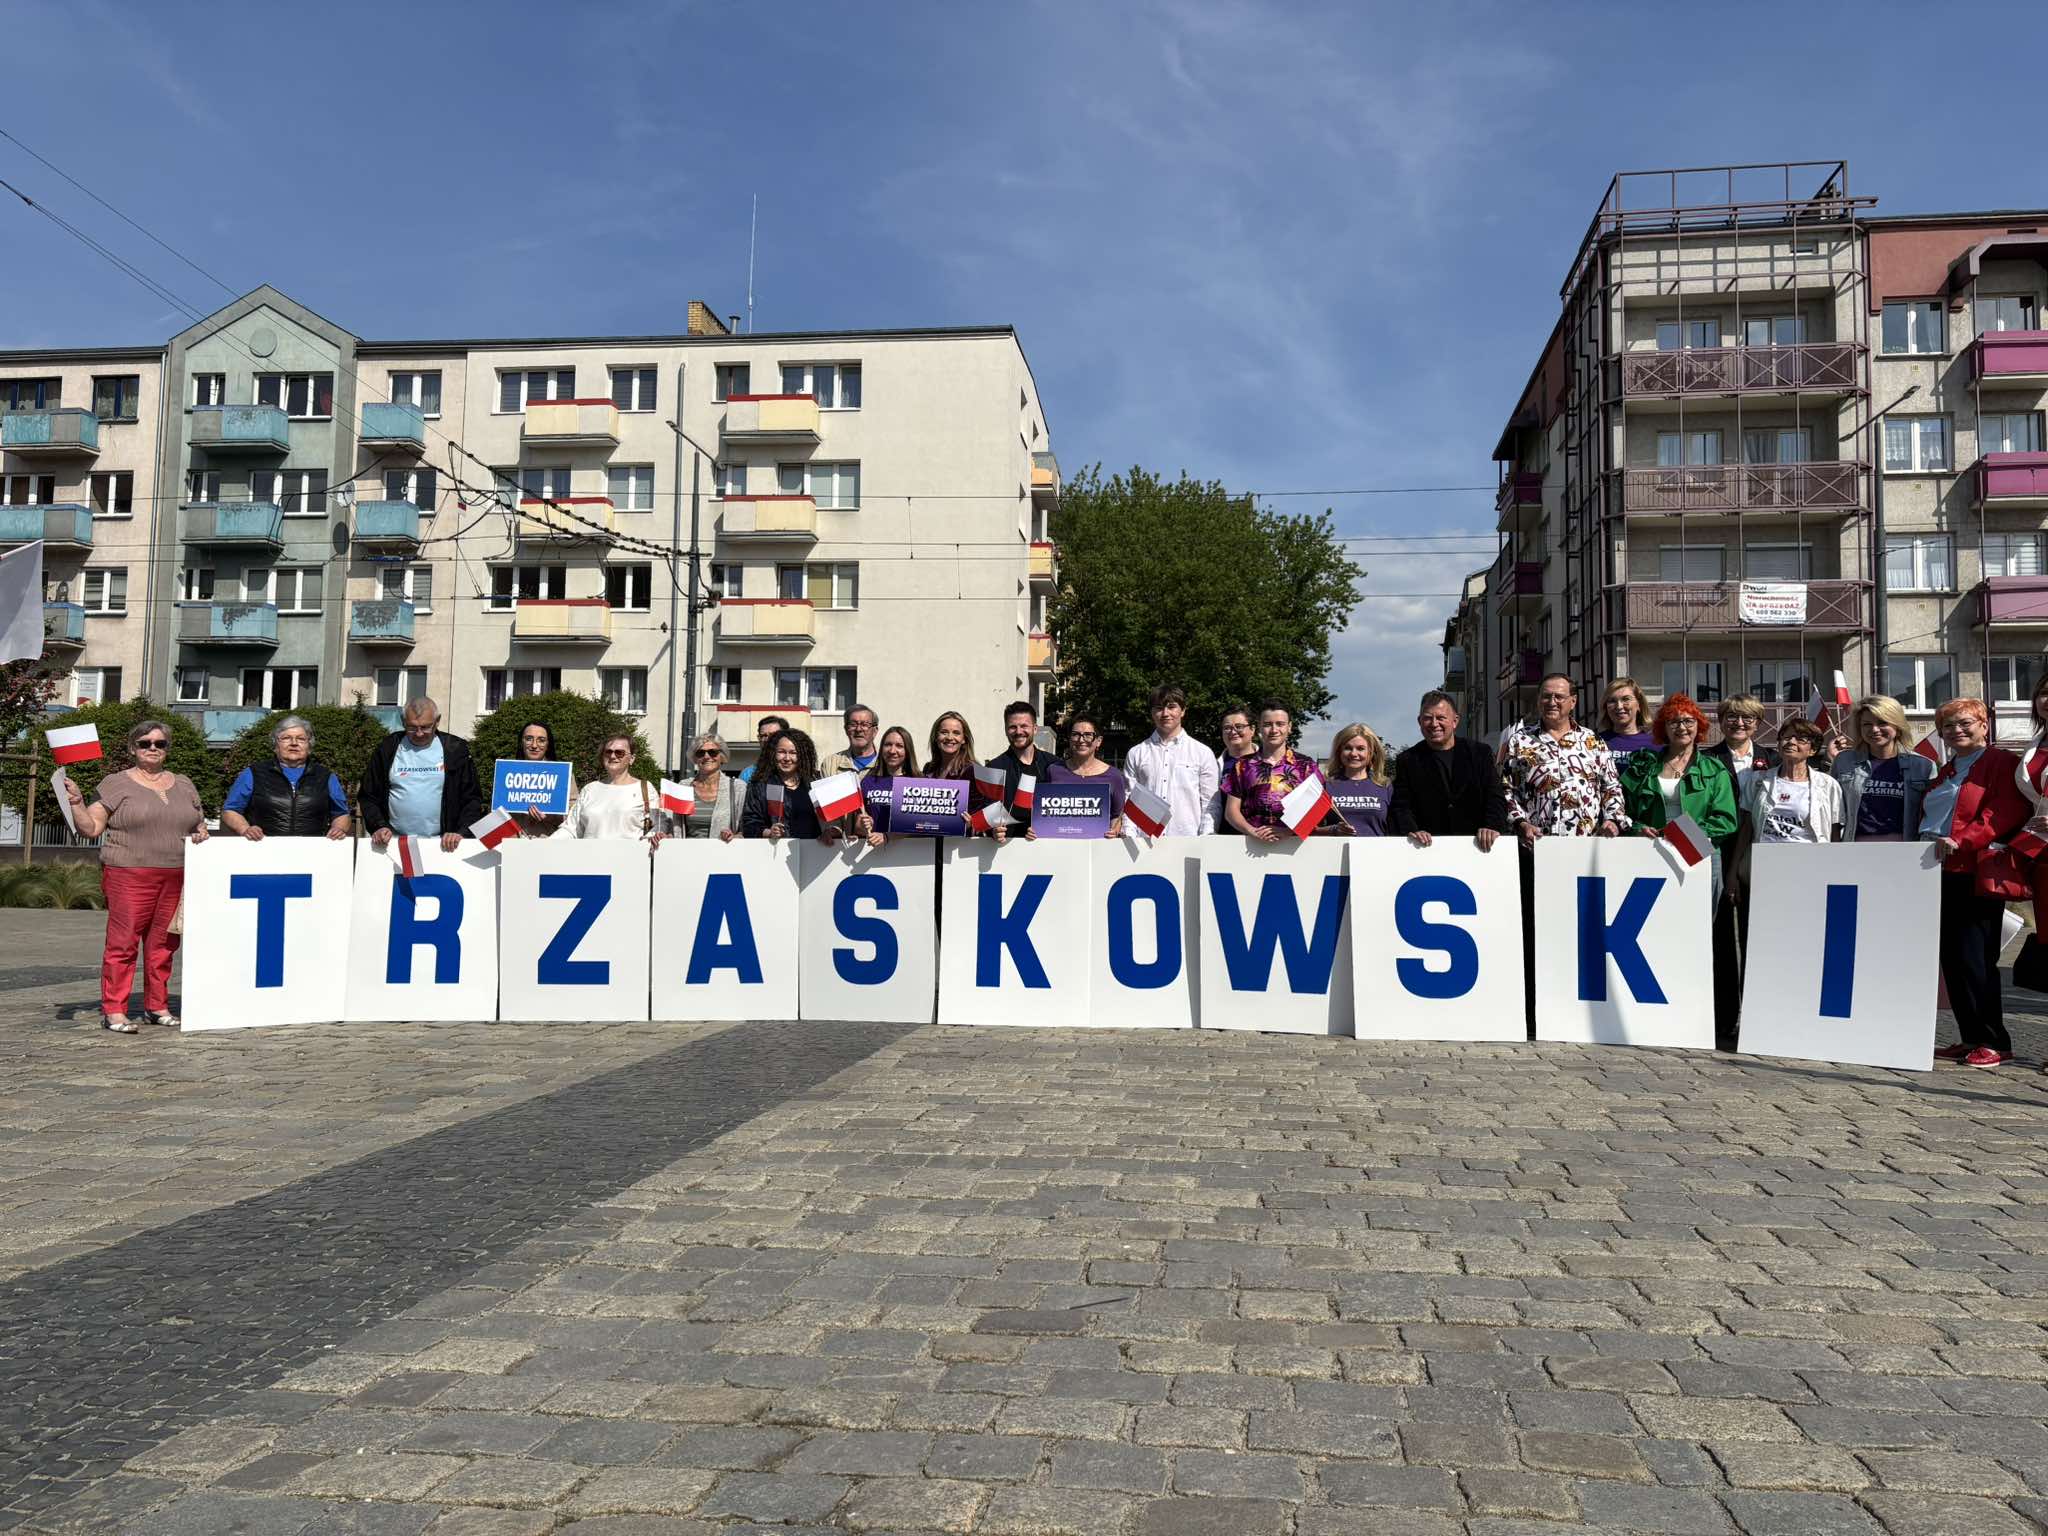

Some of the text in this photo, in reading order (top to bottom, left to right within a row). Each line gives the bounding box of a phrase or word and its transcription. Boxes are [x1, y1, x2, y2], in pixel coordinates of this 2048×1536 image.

[505, 770, 558, 790] GORZÓW
[1866, 780, 1904, 788] BIETY
[507, 790, 552, 803] NAPRZÓD!
[867, 790, 893, 798] KOBI
[903, 786, 959, 799] KOBIETY
[1862, 788, 1904, 796] ZASKIEM
[917, 798, 957, 806] WYBORY
[1041, 797, 1102, 808] KOBIETY
[901, 804, 957, 815] #TRZA2025
[1048, 808, 1101, 816] TRZASKIEM
